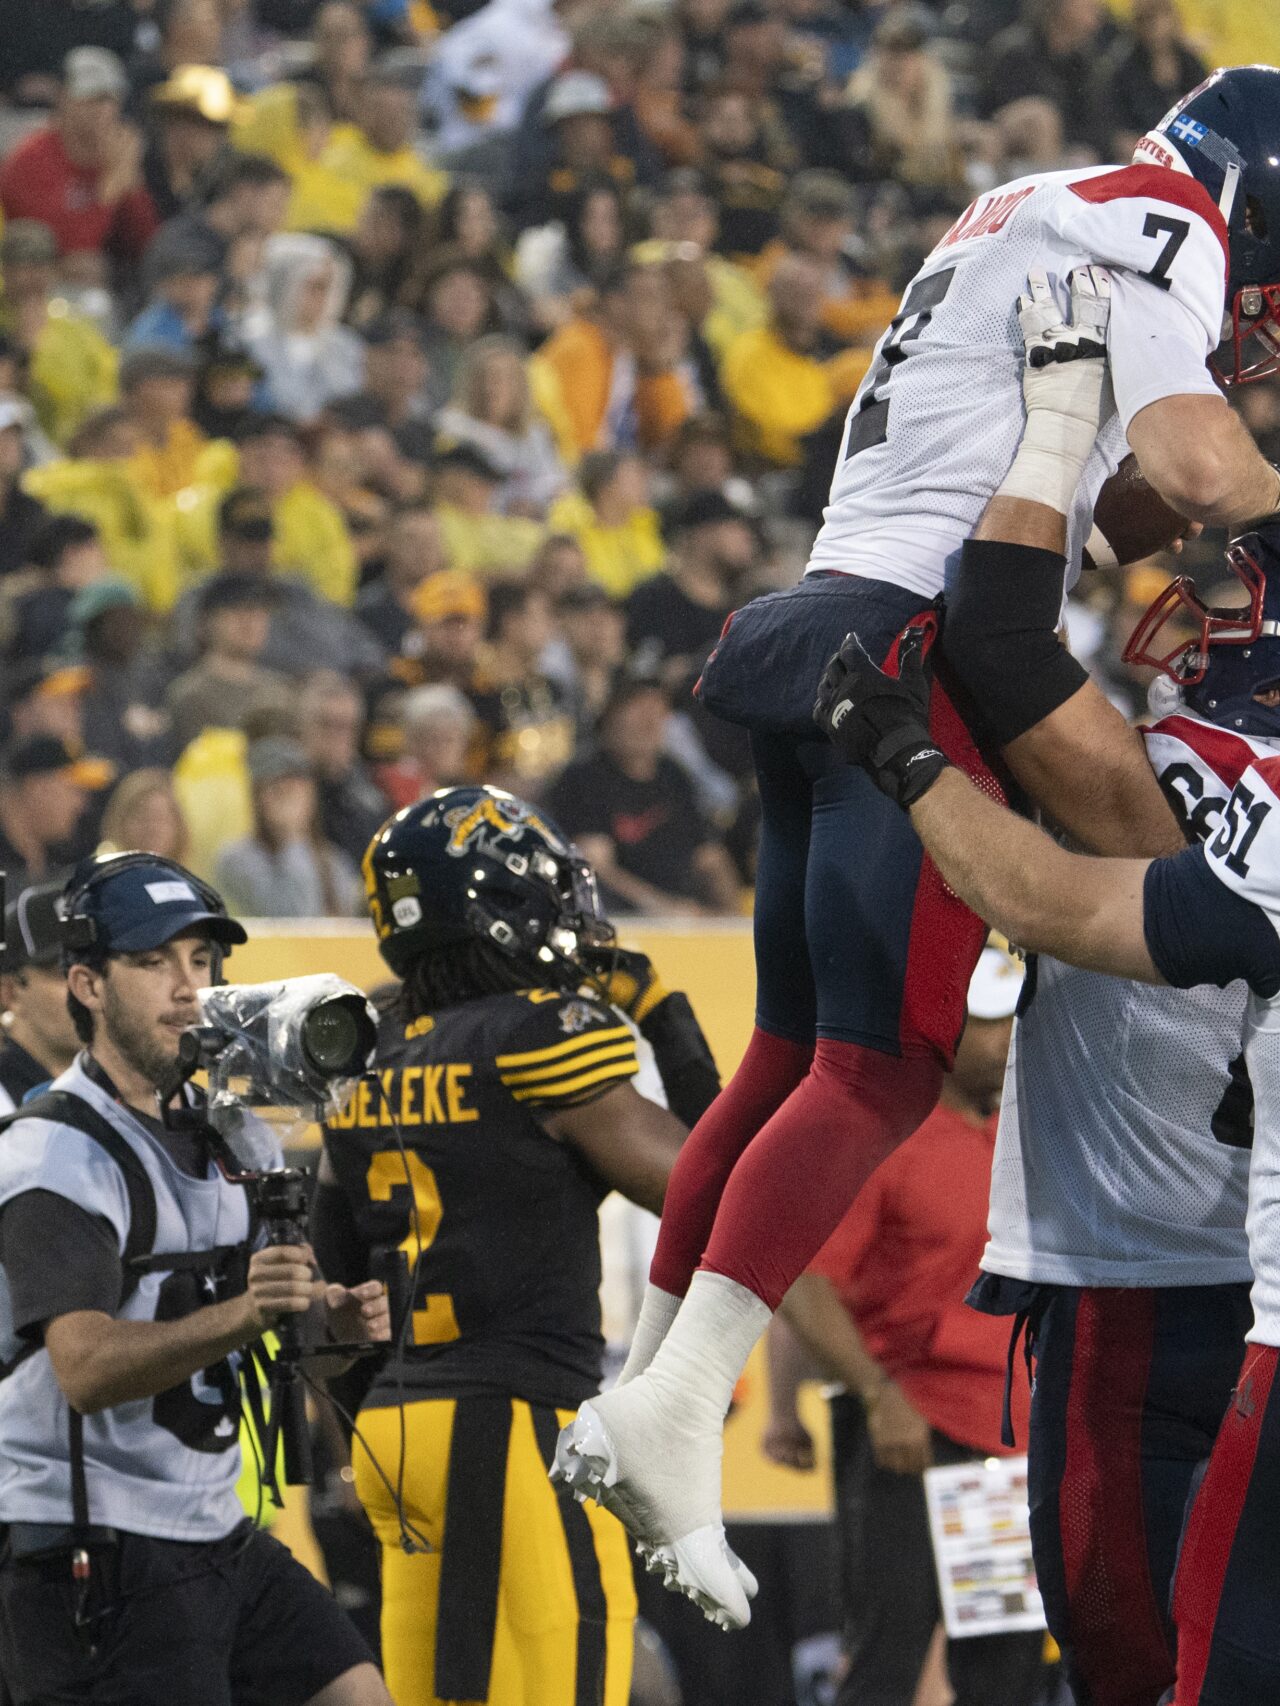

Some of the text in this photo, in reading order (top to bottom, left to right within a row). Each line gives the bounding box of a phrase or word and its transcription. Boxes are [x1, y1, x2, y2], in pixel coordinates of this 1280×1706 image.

[1138, 212, 1190, 291] 7
[1209, 781, 1272, 879] 51
[366, 1149, 461, 1345] 2
